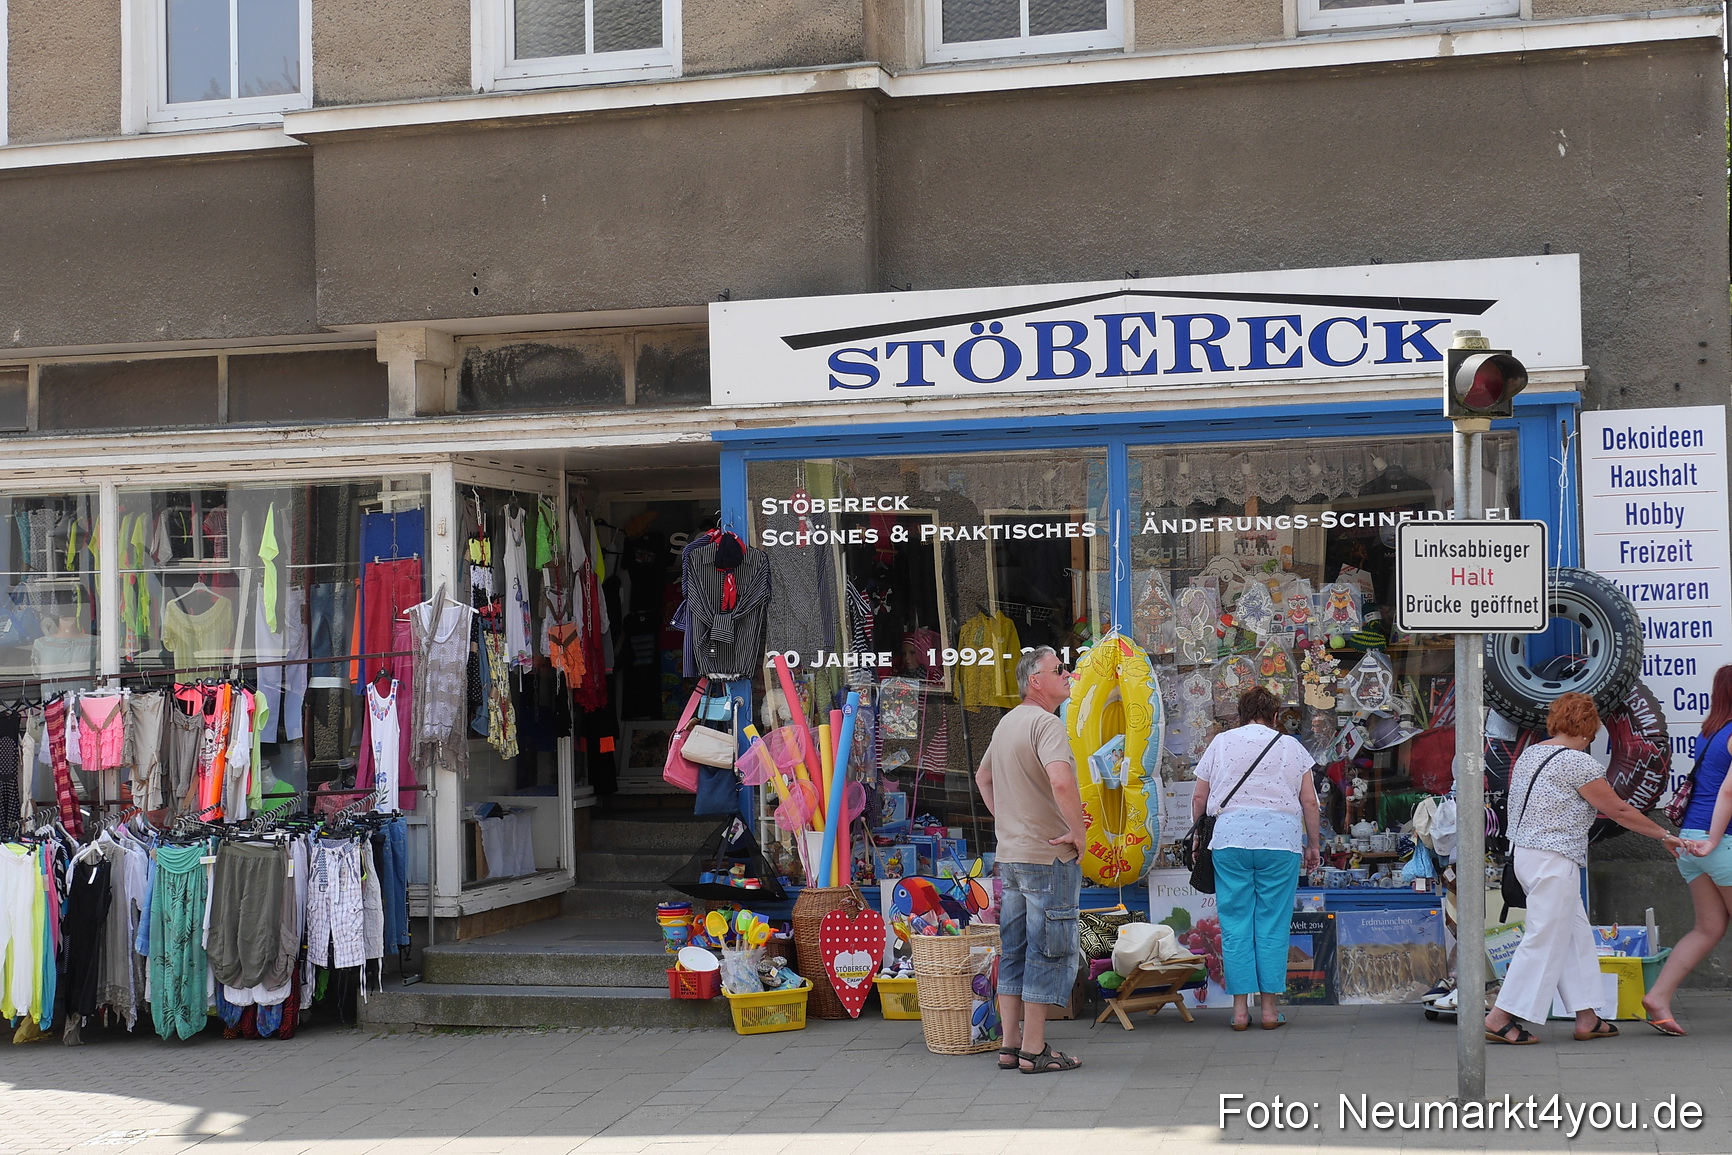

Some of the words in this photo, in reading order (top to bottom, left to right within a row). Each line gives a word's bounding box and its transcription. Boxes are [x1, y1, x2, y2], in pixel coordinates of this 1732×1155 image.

[828, 311, 1453, 391] STÖBERECK
[1602, 425, 1704, 451] Dekoideen
[1610, 462, 1698, 488] Haushalt
[1625, 501, 1685, 529] Hobby
[890, 525, 909, 542] &
[1414, 539, 1531, 563] Linksabbieger
[1620, 538, 1693, 564] Freizeit
[1451, 568, 1494, 586] Halt
[1406, 595, 1462, 613] Brücke
[1471, 595, 1539, 618] geöffnet
[1640, 617, 1713, 639] elwaren
[927, 648, 995, 666] 1992
[1641, 654, 1697, 677] ützen
[1309, 922, 1324, 930] 2014
[1361, 916, 1414, 927] Erdmännchen
[1488, 945, 1503, 955] Der
